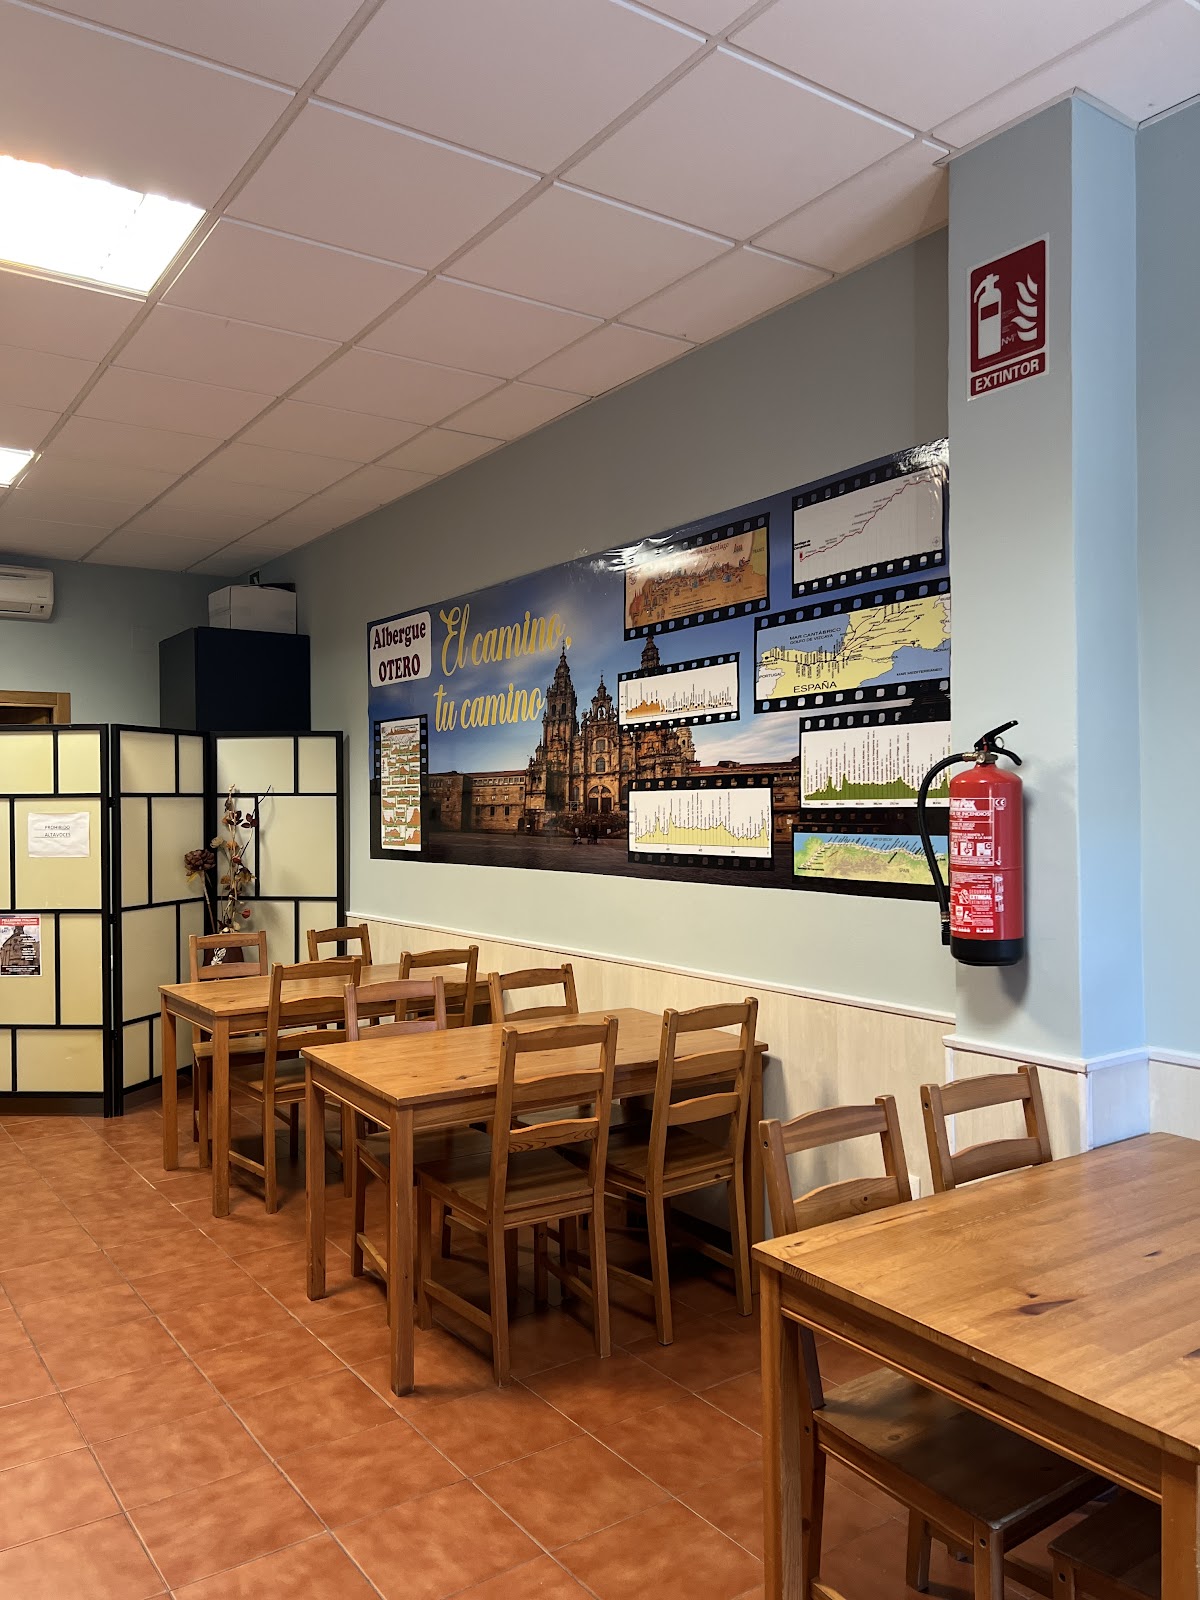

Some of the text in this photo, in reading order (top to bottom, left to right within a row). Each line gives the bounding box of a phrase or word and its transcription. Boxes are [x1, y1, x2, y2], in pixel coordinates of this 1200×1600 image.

[975, 359, 1040, 392] EXTINTOR
[372, 622, 427, 650] Albergue
[439, 603, 573, 677] El camino,
[803, 627, 842, 638] CANTÁBRICO
[378, 653, 421, 682] OTERO
[793, 680, 838, 694] ESPAÑA
[433, 682, 546, 733] tu camino
